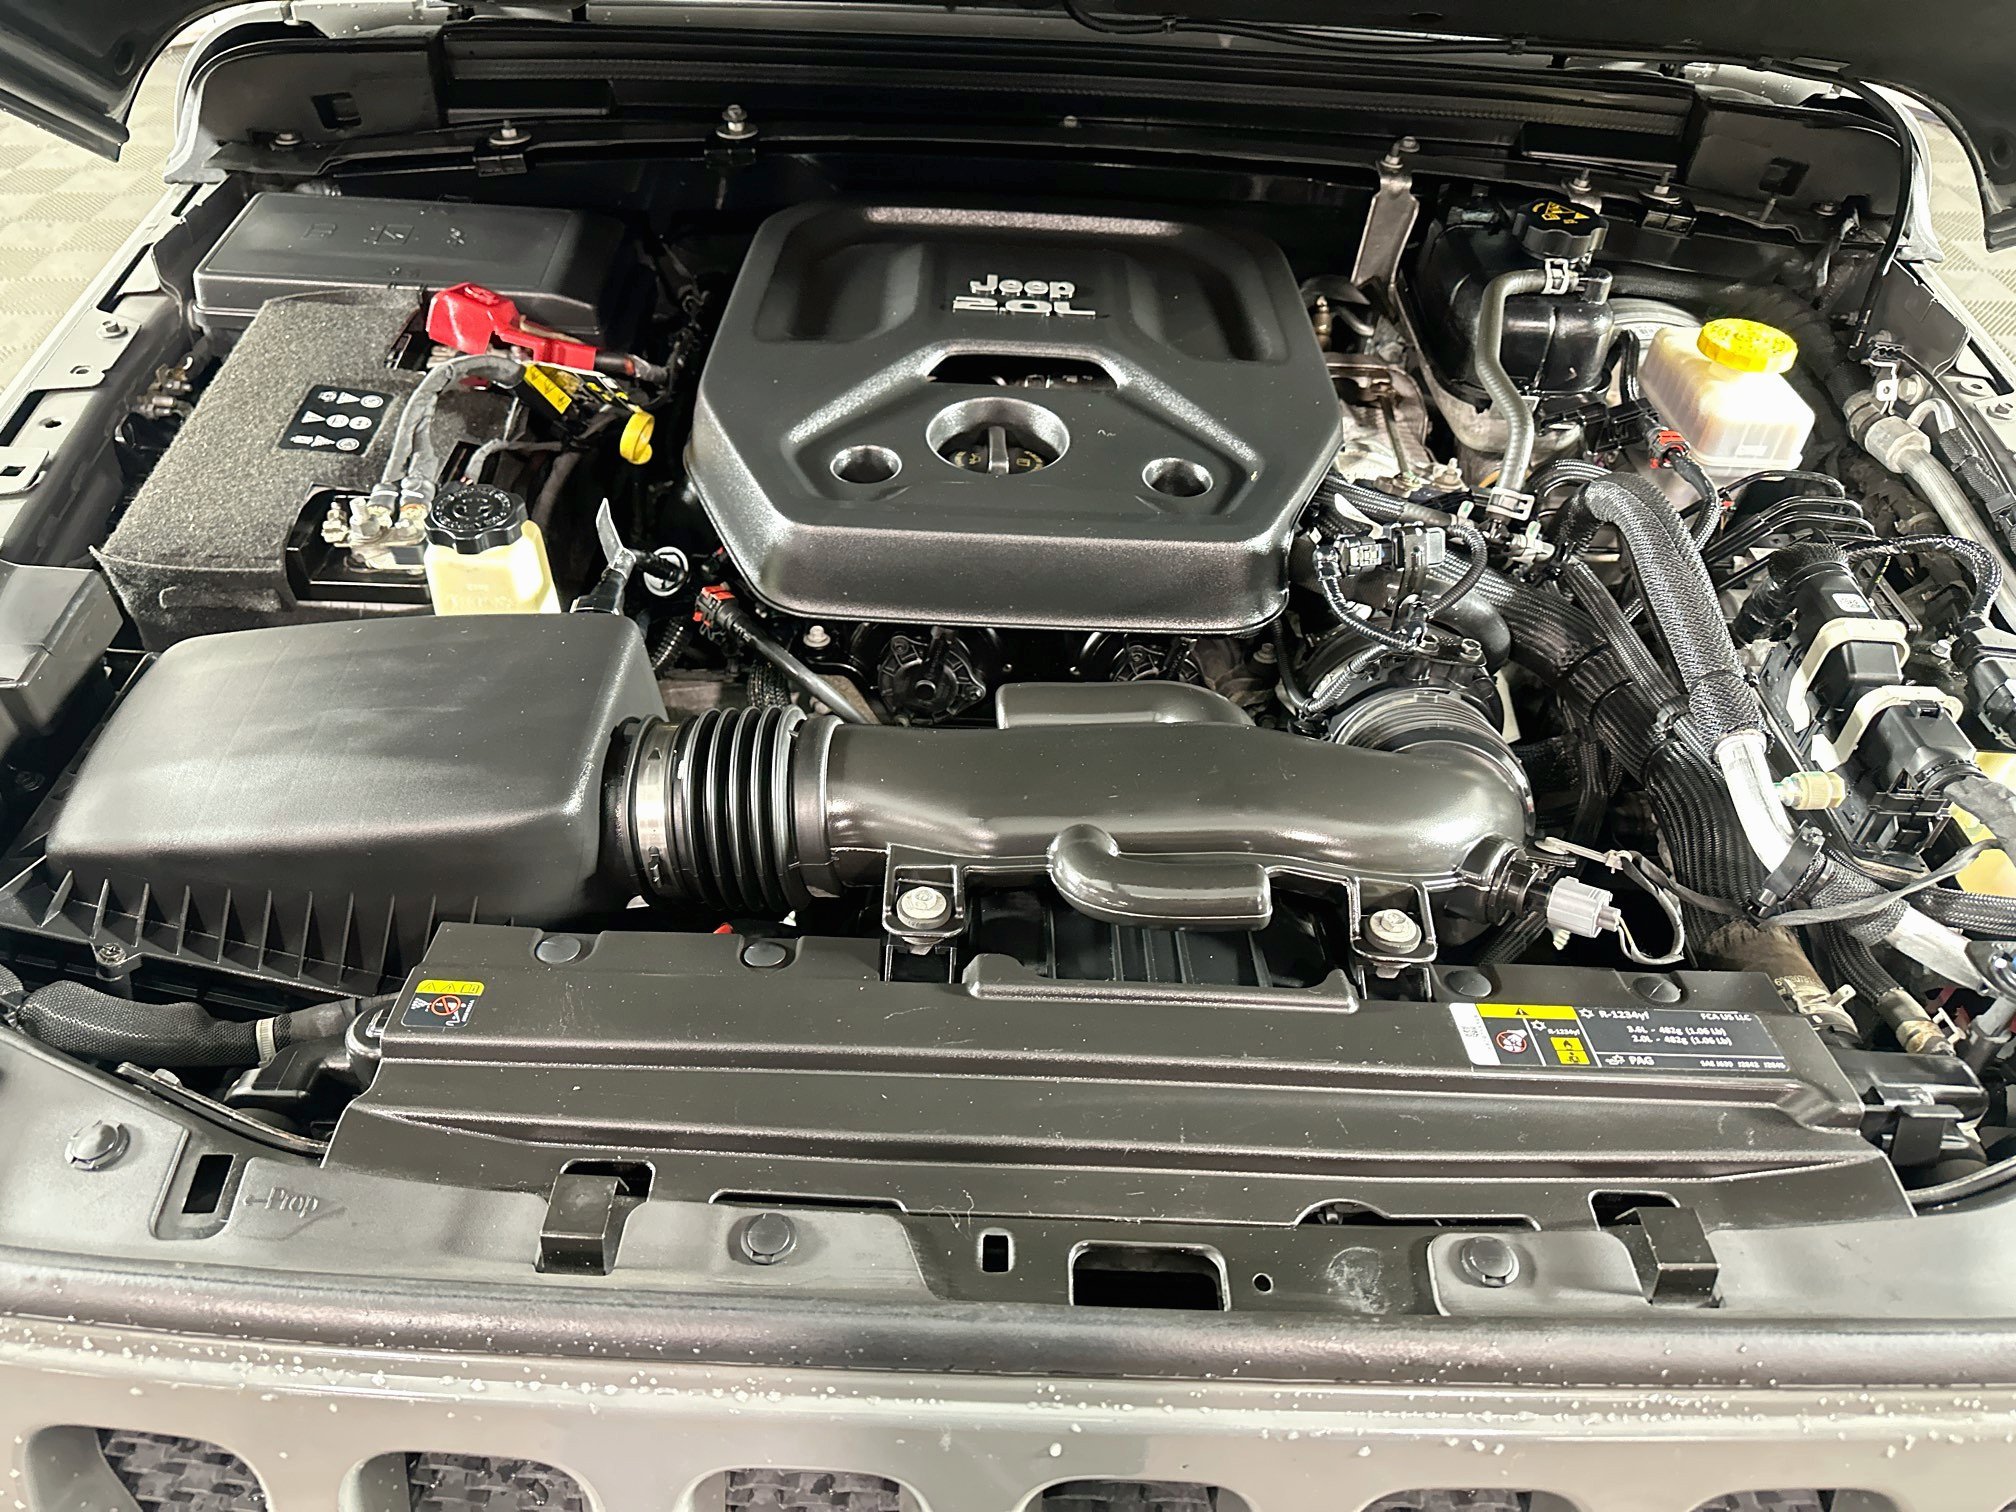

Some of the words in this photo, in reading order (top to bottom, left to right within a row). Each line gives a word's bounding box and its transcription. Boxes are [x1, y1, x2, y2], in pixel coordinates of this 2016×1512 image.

[970, 274, 1075, 299] Jeep
[953, 296, 1096, 316] 2.0L
[1720, 1013, 1734, 1021] US
[1628, 1056, 1655, 1066] PAG
[264, 1186, 319, 1218] Prop
